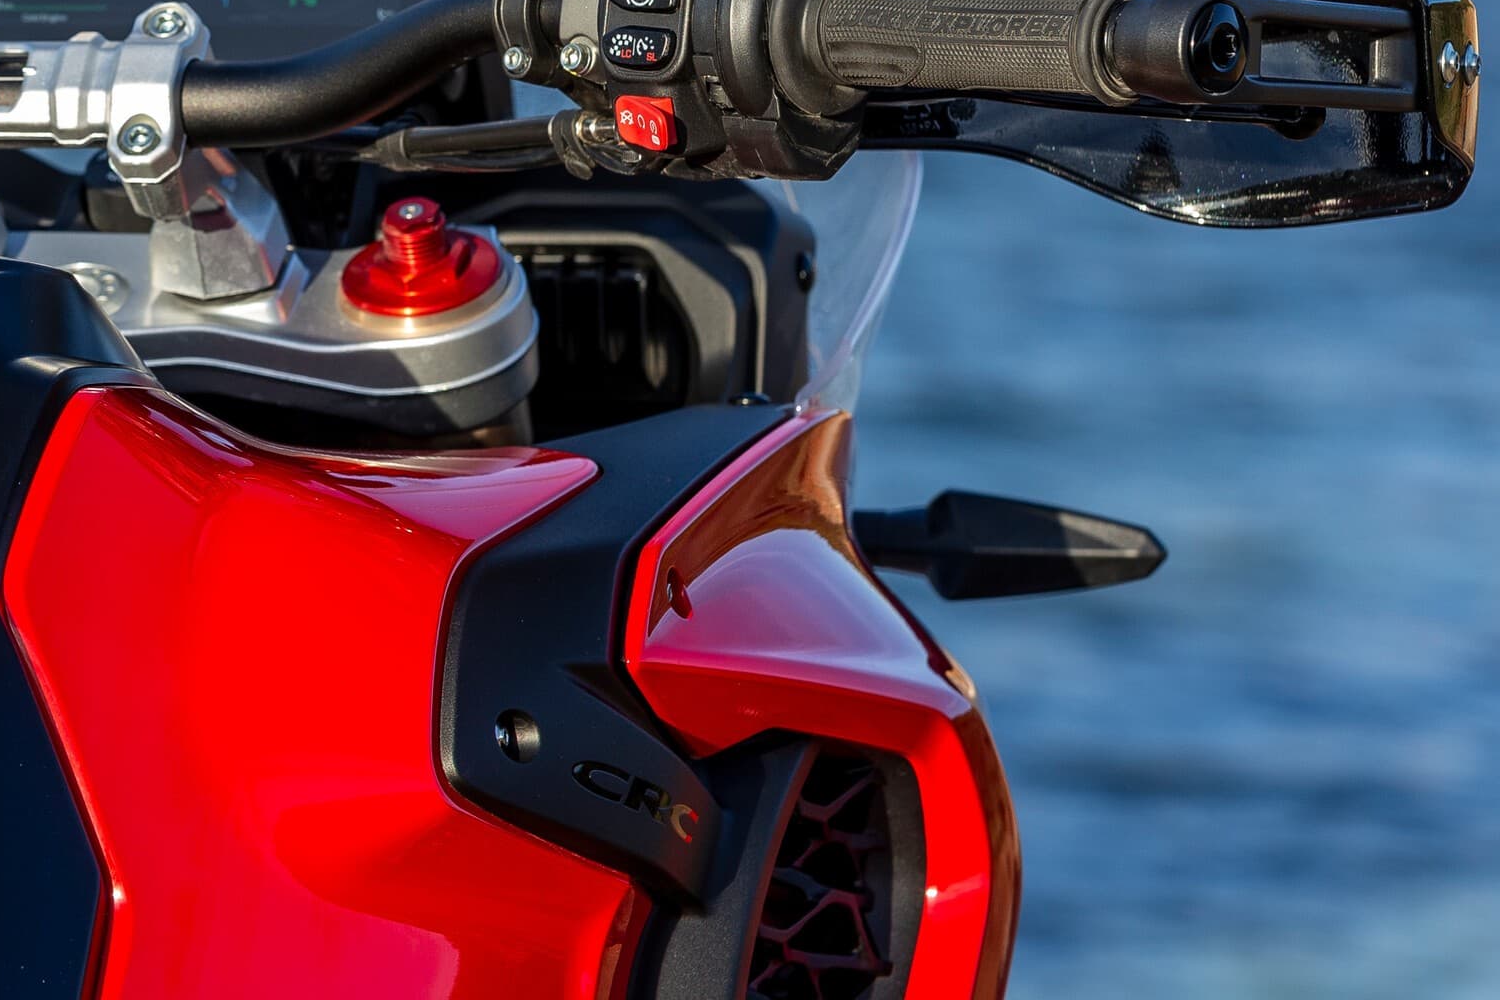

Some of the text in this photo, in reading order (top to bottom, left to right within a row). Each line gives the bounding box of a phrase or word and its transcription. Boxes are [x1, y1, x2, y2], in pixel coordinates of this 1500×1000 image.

[918, 12, 1072, 37] EXPLORER
[621, 49, 657, 62] LC SL
